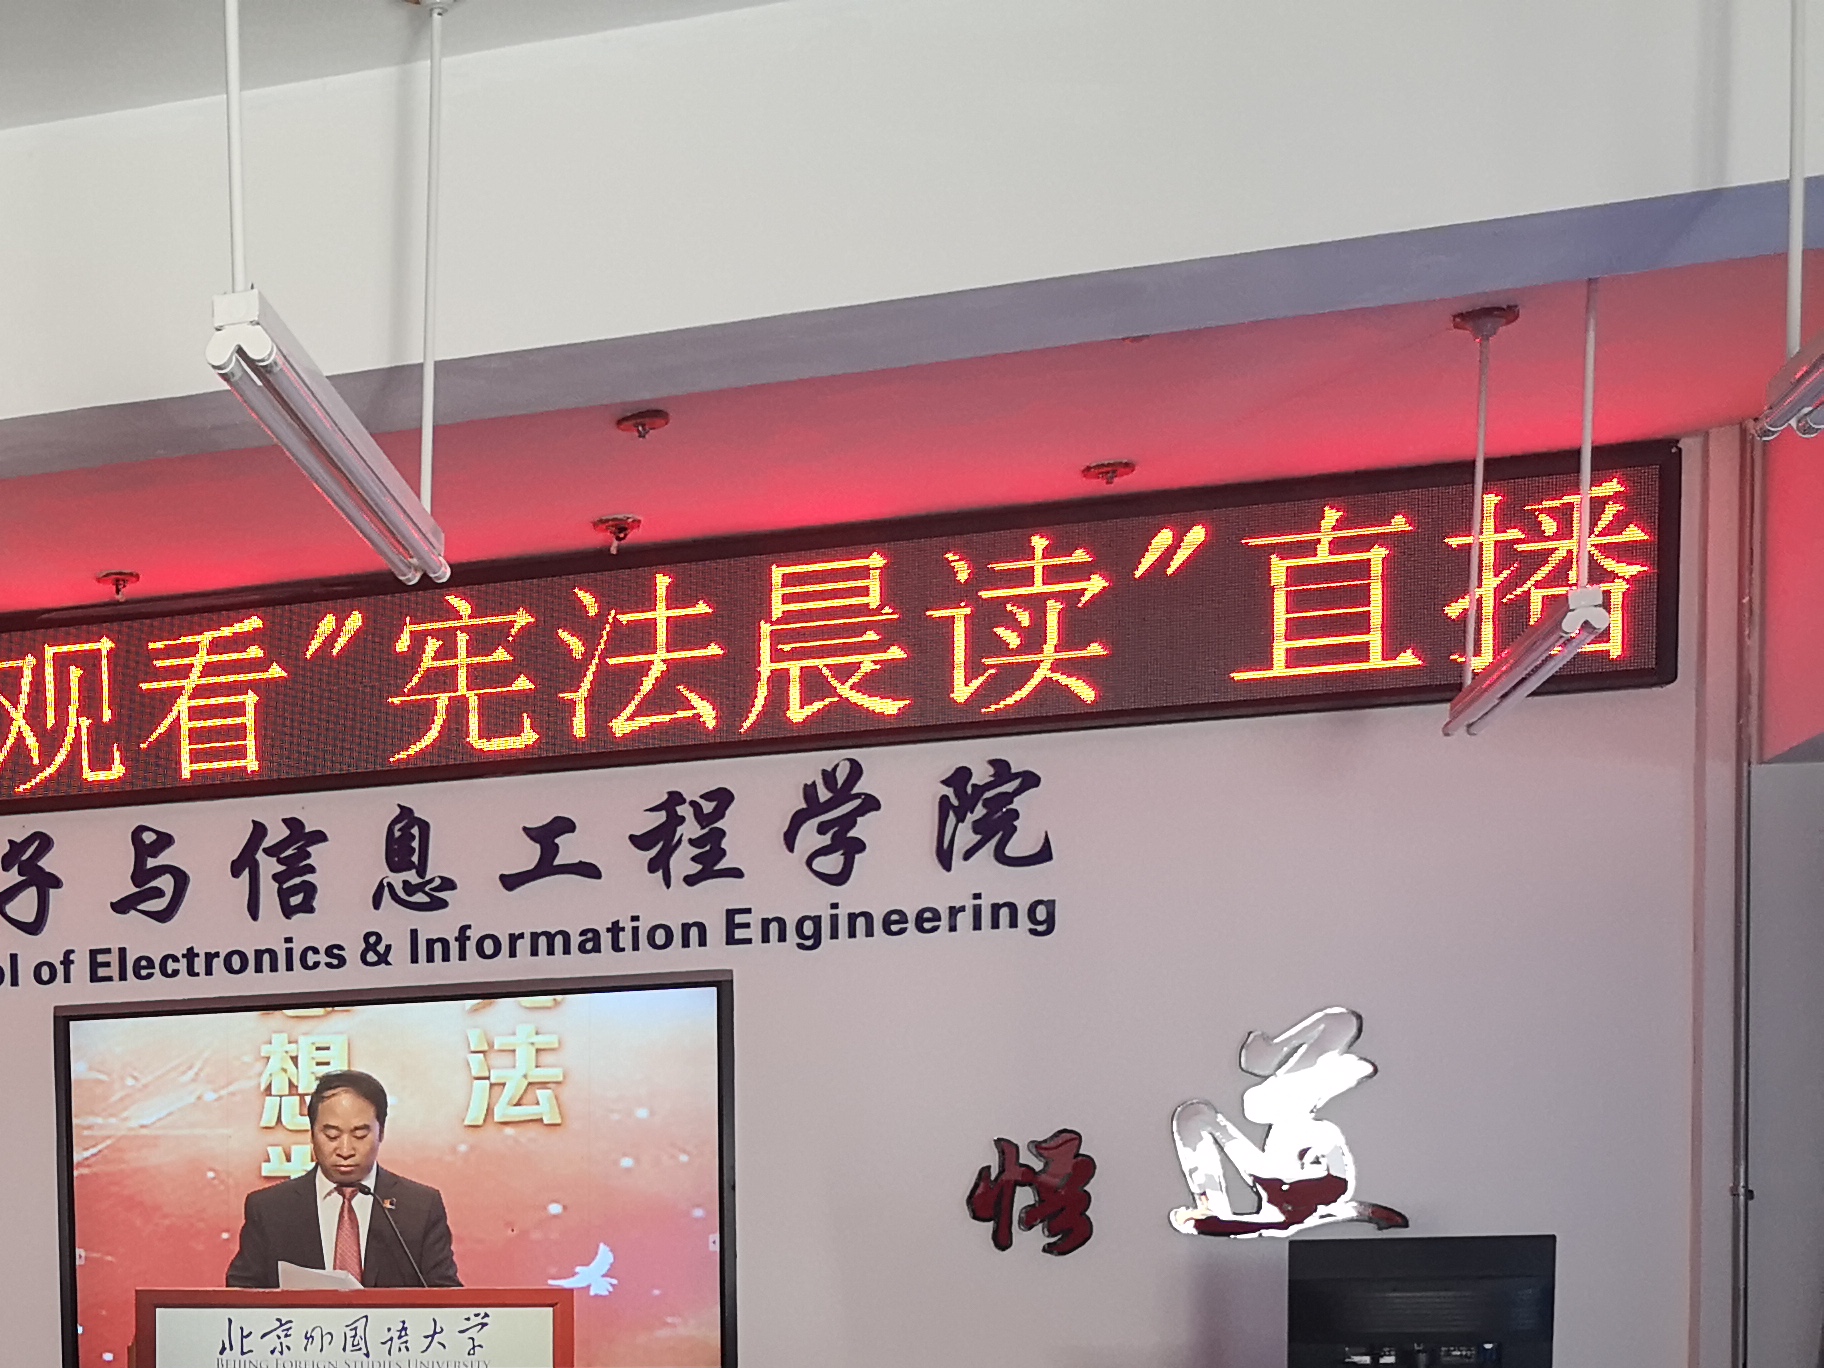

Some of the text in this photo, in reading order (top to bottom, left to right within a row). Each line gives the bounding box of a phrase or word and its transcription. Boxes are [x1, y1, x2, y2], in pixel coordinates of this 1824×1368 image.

[33, 948, 77, 987] of
[88, 935, 348, 985] Electronics
[359, 929, 394, 968] &
[409, 914, 709, 966] Information
[725, 891, 1057, 952] Engineering
[462, 996, 564, 1127] 法
